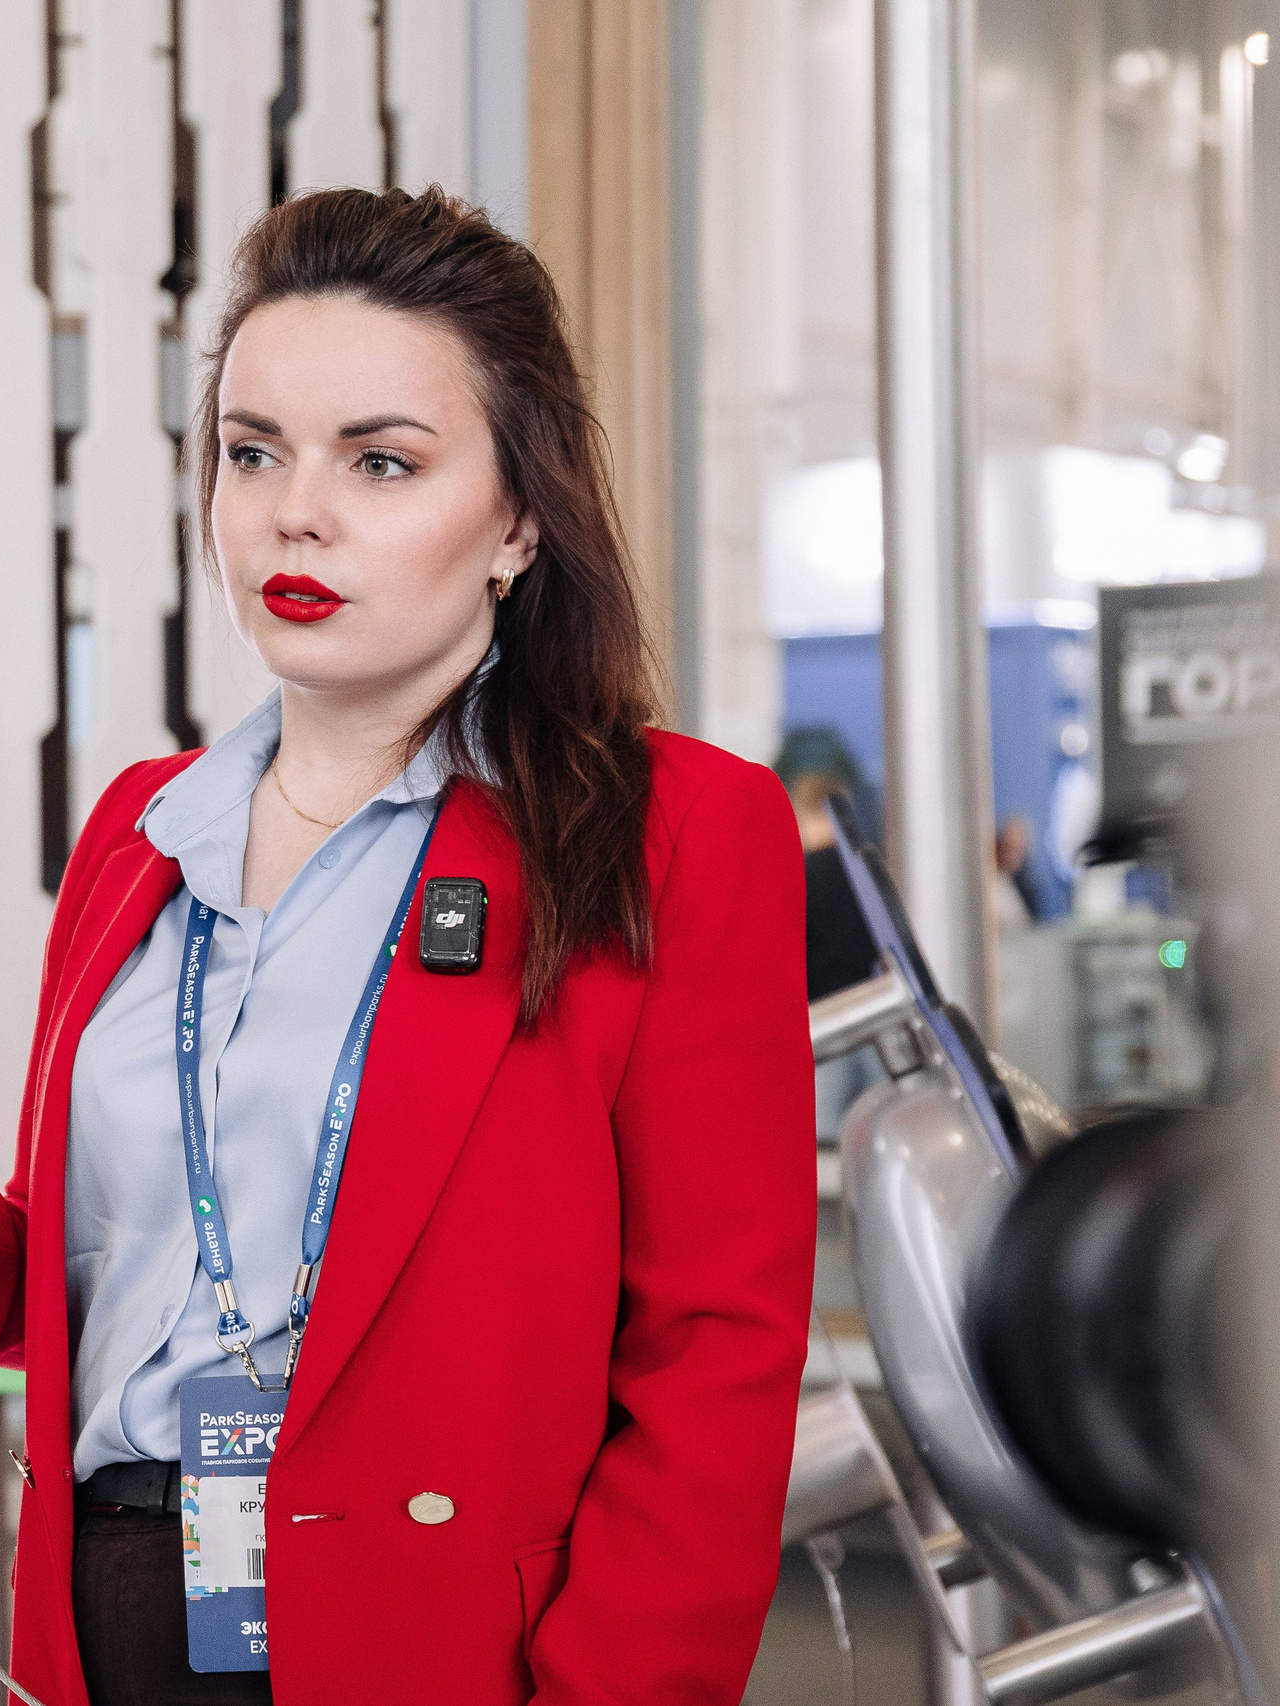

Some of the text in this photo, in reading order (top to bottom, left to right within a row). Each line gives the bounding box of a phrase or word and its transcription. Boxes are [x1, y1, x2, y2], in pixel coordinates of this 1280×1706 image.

[183, 1009, 195, 1053] EXPO
[349, 973, 389, 1066] expo.urbanparks.ru
[185, 1073, 202, 1174] expo.urbanparks.ru
[330, 1083, 352, 1132] EXPO
[204, 1221, 225, 1275] аданат
[240, 1501, 266, 1513] КРУ
[241, 1621, 268, 1635] ЭК
[250, 1640, 268, 1654] EX
